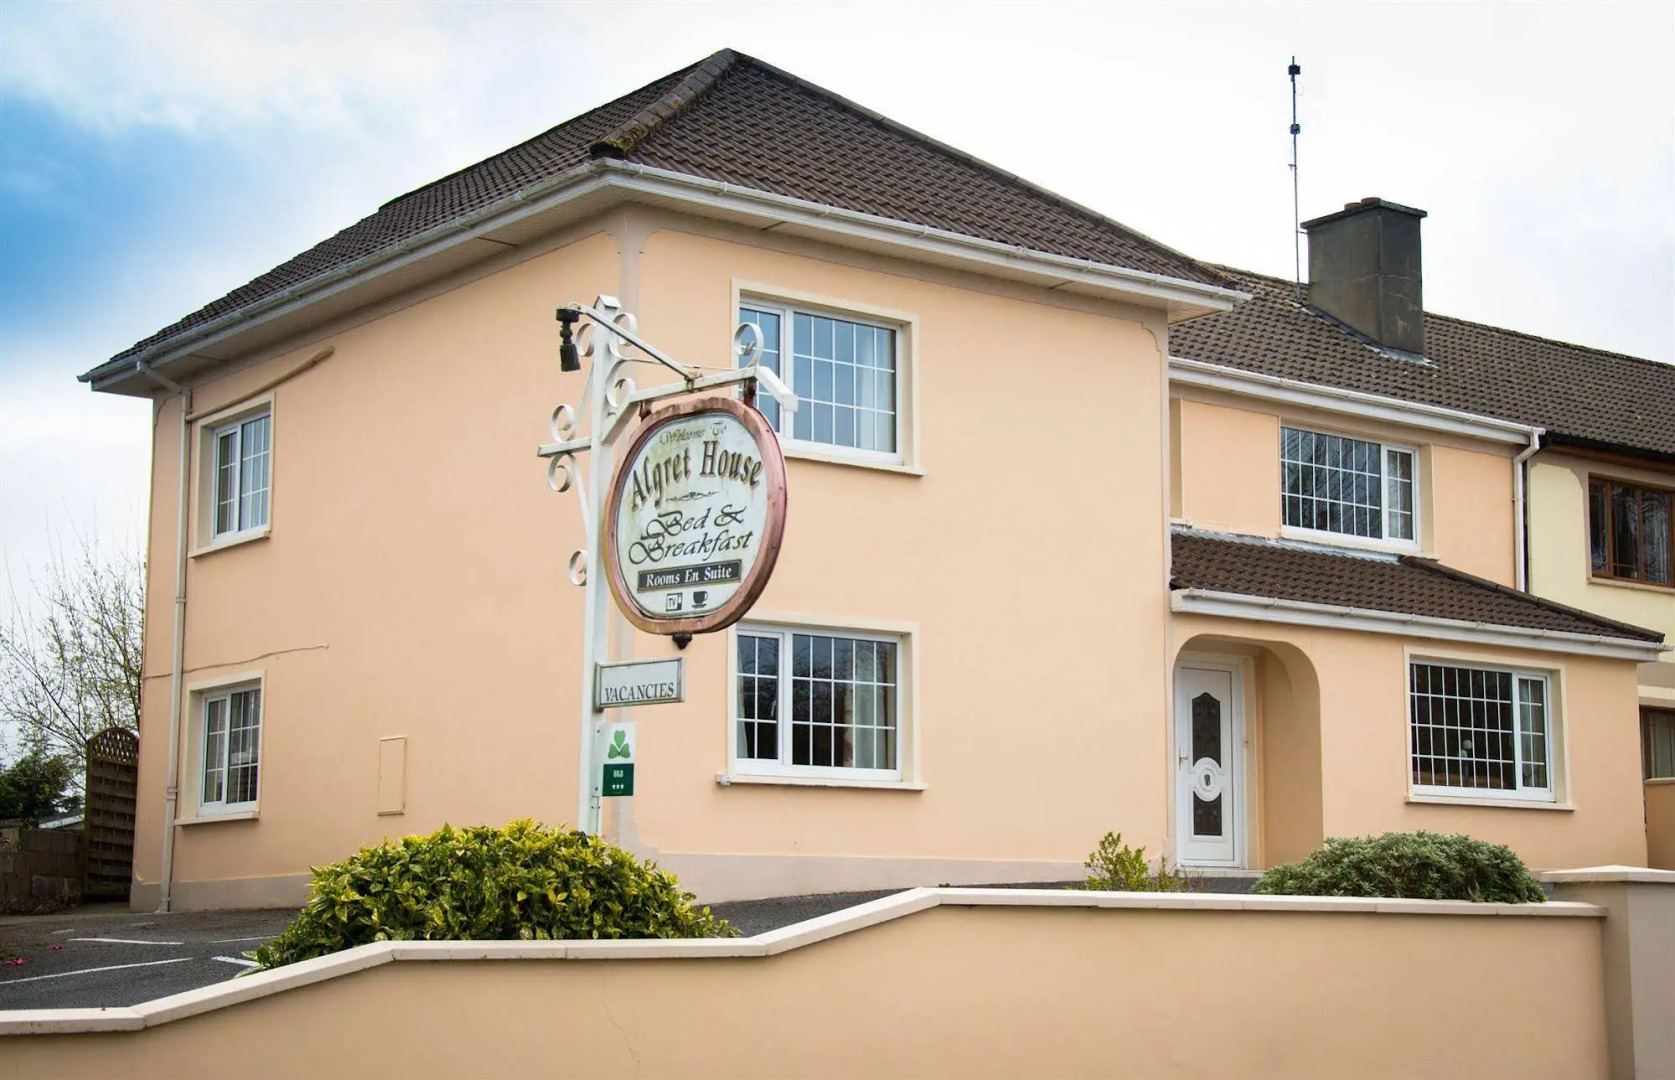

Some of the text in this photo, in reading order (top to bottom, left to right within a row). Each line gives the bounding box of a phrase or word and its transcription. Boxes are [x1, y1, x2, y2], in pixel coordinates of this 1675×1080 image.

[660, 422, 728, 446] Welcome To
[631, 440, 764, 513] Algret House
[646, 503, 747, 538] Bed &
[628, 529, 754, 565] Breakfast
[646, 565, 732, 588] Rooms En Suite
[668, 597, 677, 608] TV
[605, 682, 675, 702] VACANCIES
